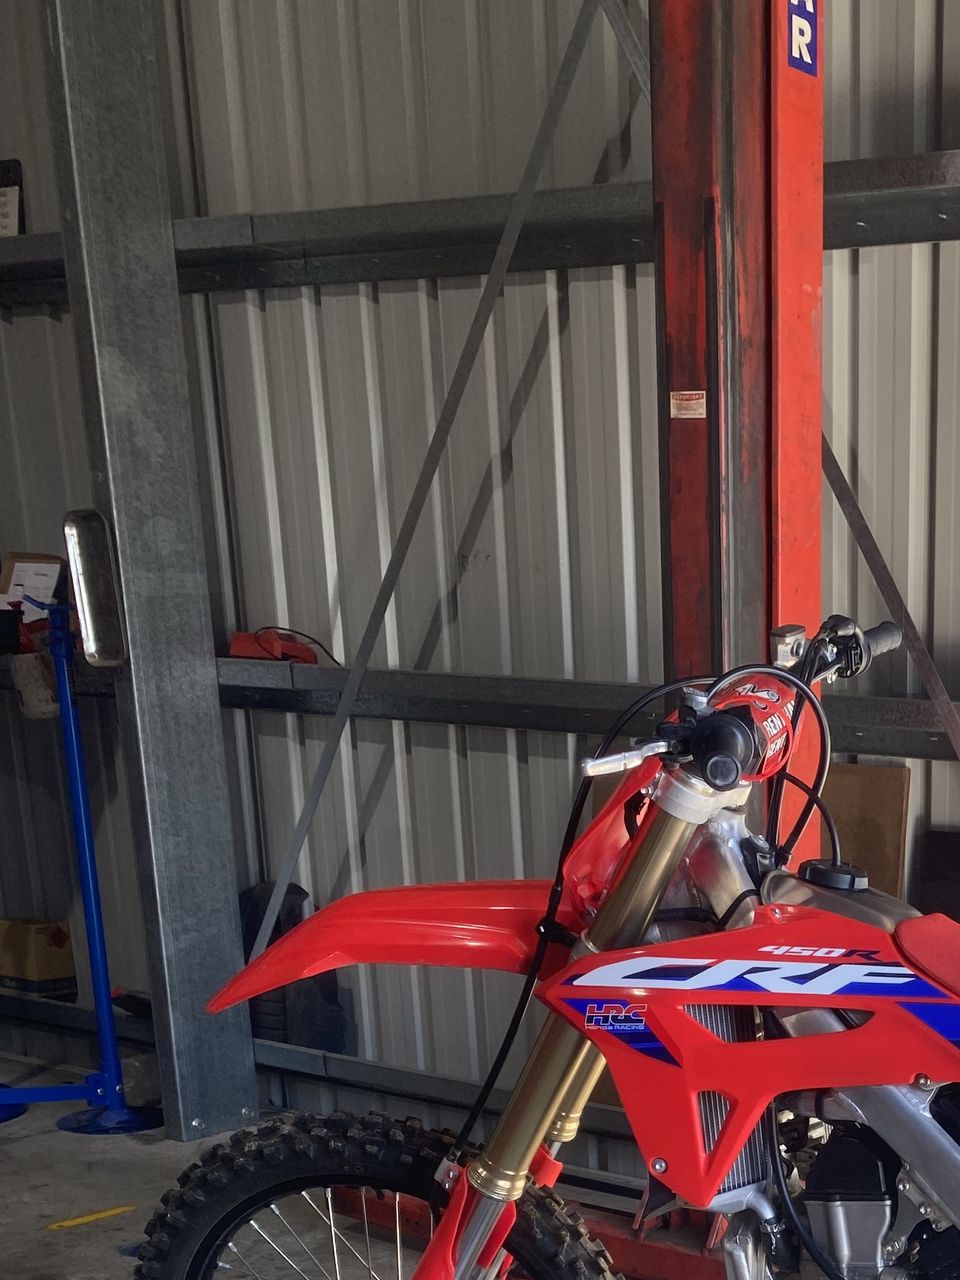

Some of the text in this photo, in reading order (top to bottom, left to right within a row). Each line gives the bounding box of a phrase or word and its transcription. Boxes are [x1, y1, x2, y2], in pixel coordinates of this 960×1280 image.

[758, 945, 882, 962] 450R
[573, 956, 916, 995] CRF
[585, 1004, 648, 1025] HRC
